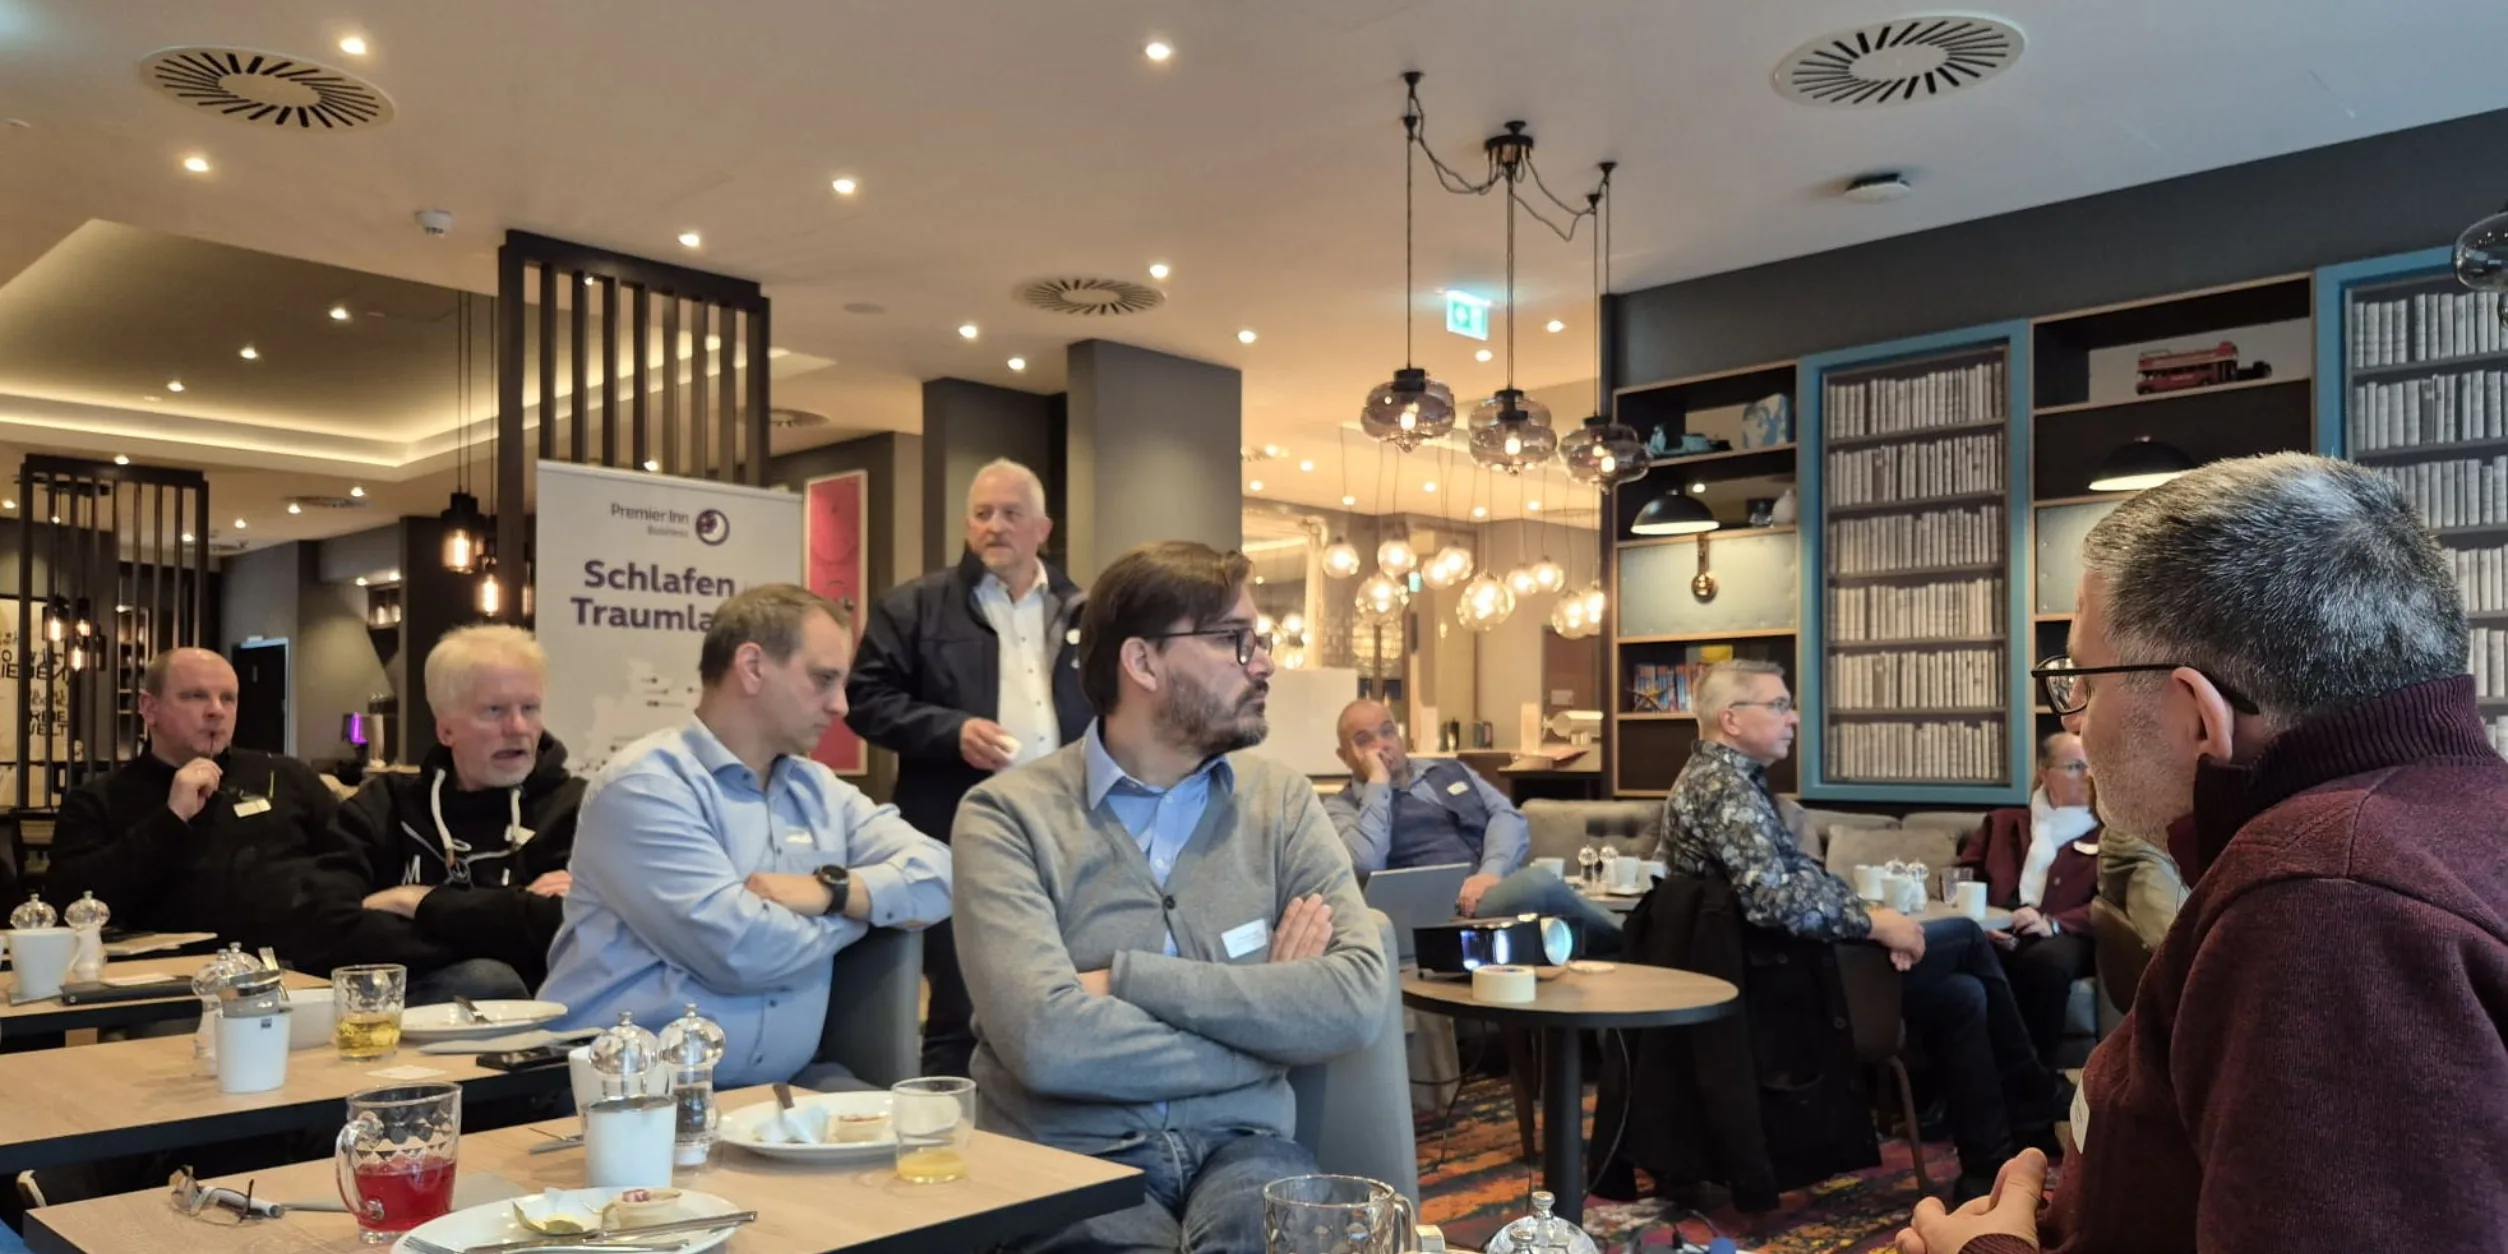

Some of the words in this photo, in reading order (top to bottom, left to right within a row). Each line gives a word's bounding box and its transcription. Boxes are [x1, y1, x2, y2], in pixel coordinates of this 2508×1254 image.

[611, 502, 667, 521] Premier
[669, 510, 689, 523] Inn
[647, 526, 689, 538] Business
[584, 560, 735, 597] Schlafen
